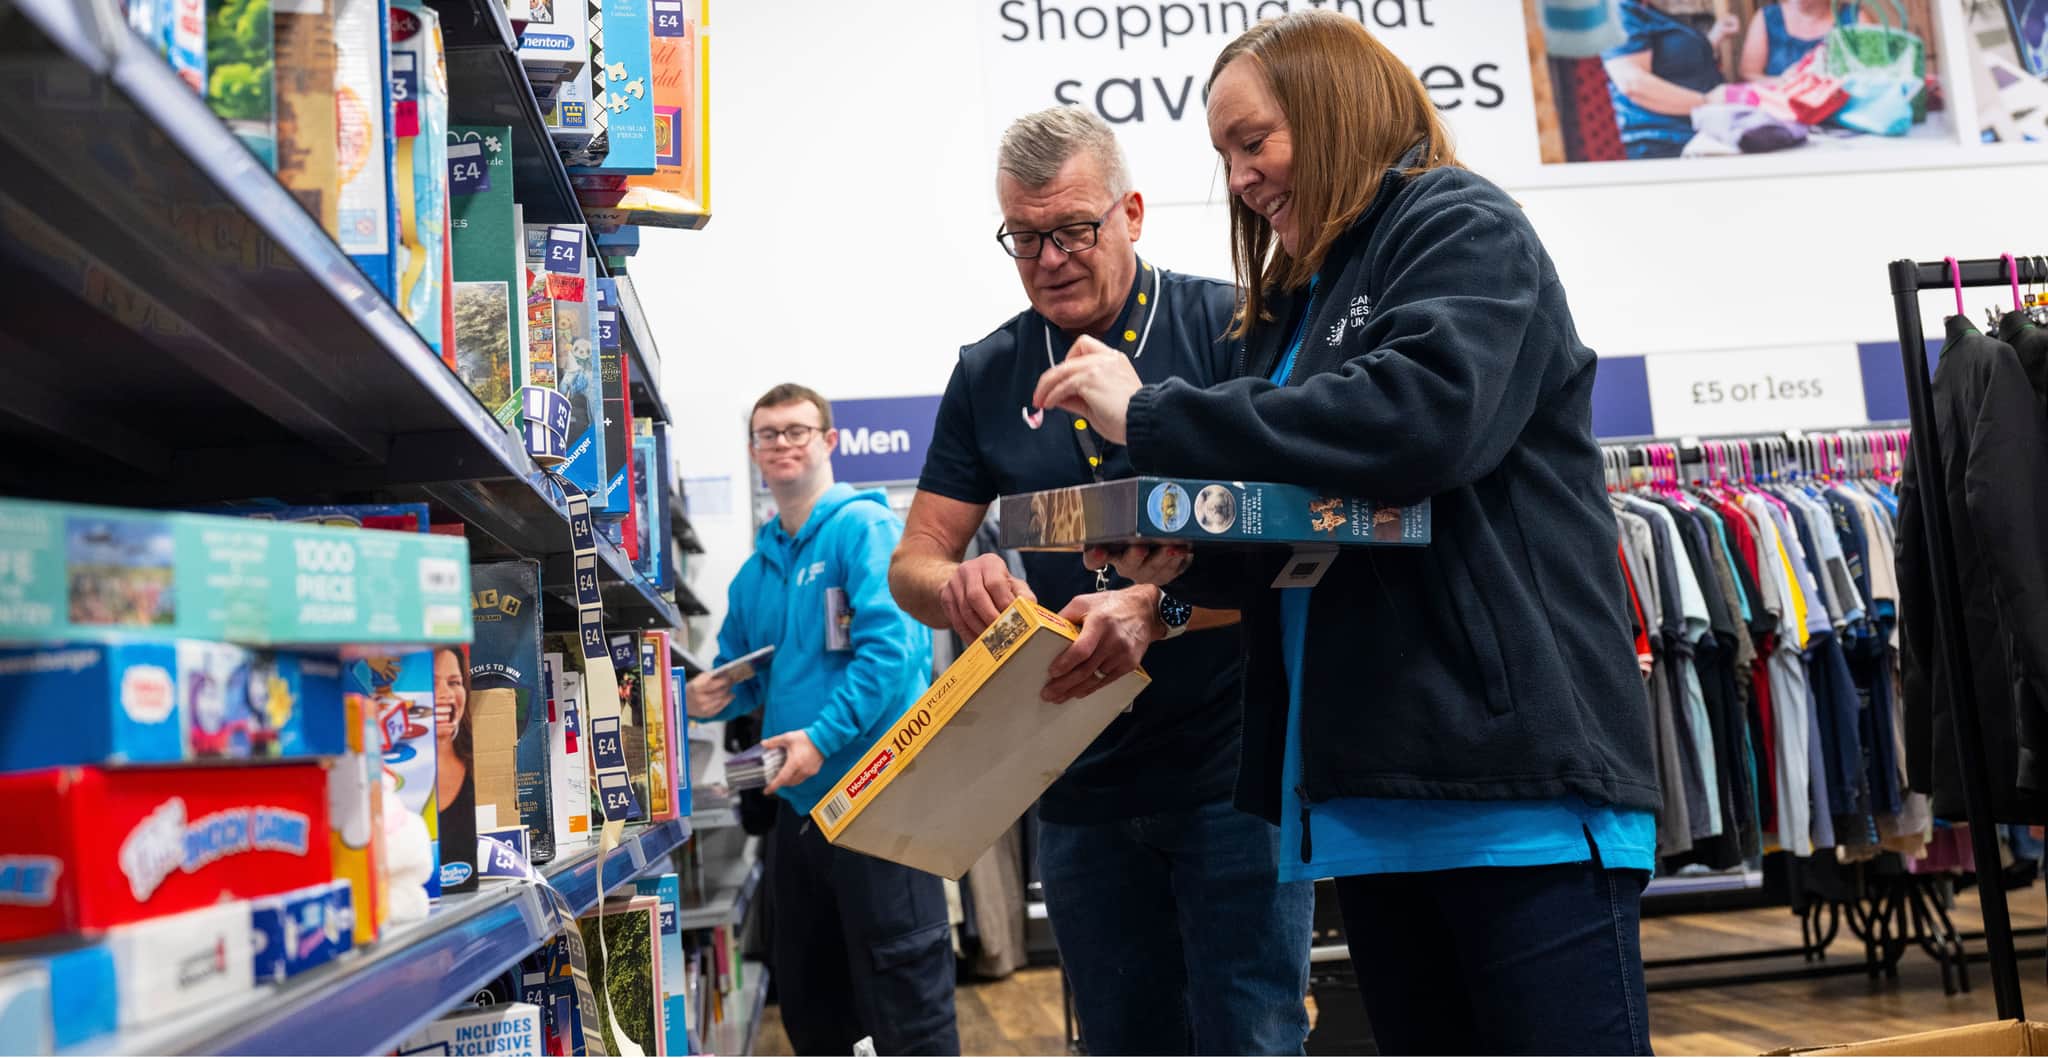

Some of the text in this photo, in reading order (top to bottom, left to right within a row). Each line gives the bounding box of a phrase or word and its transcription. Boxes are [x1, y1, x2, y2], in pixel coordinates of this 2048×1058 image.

[658, 14, 680, 28] £4
[1308, 0, 1435, 28] hat
[391, 78, 408, 101] 3
[1054, 74, 1209, 124] sav
[453, 162, 481, 182] £4
[552, 245, 575, 261] £4
[1351, 316, 1365, 328] UK
[1692, 375, 1823, 405] £5 or less
[557, 402, 568, 430] £4
[840, 427, 910, 456] Men
[1361, 500, 1369, 536] PUZZL
[574, 519, 588, 537] £4
[580, 574, 594, 591] £4
[473, 589, 521, 616] CH
[585, 629, 600, 646] £4
[616, 648, 631, 660] £4
[643, 656, 651, 668] 4
[505, 666, 521, 679] WIN
[926, 676, 958, 709] PUZZLE
[564, 716, 574, 728] 4
[892, 709, 932, 755] 1000
[598, 738, 616, 755] £4
[607, 792, 630, 809] £4
[496, 847, 515, 870] £3
[526, 989, 543, 1004] £4
[456, 1018, 531, 1041] INCLUDES
